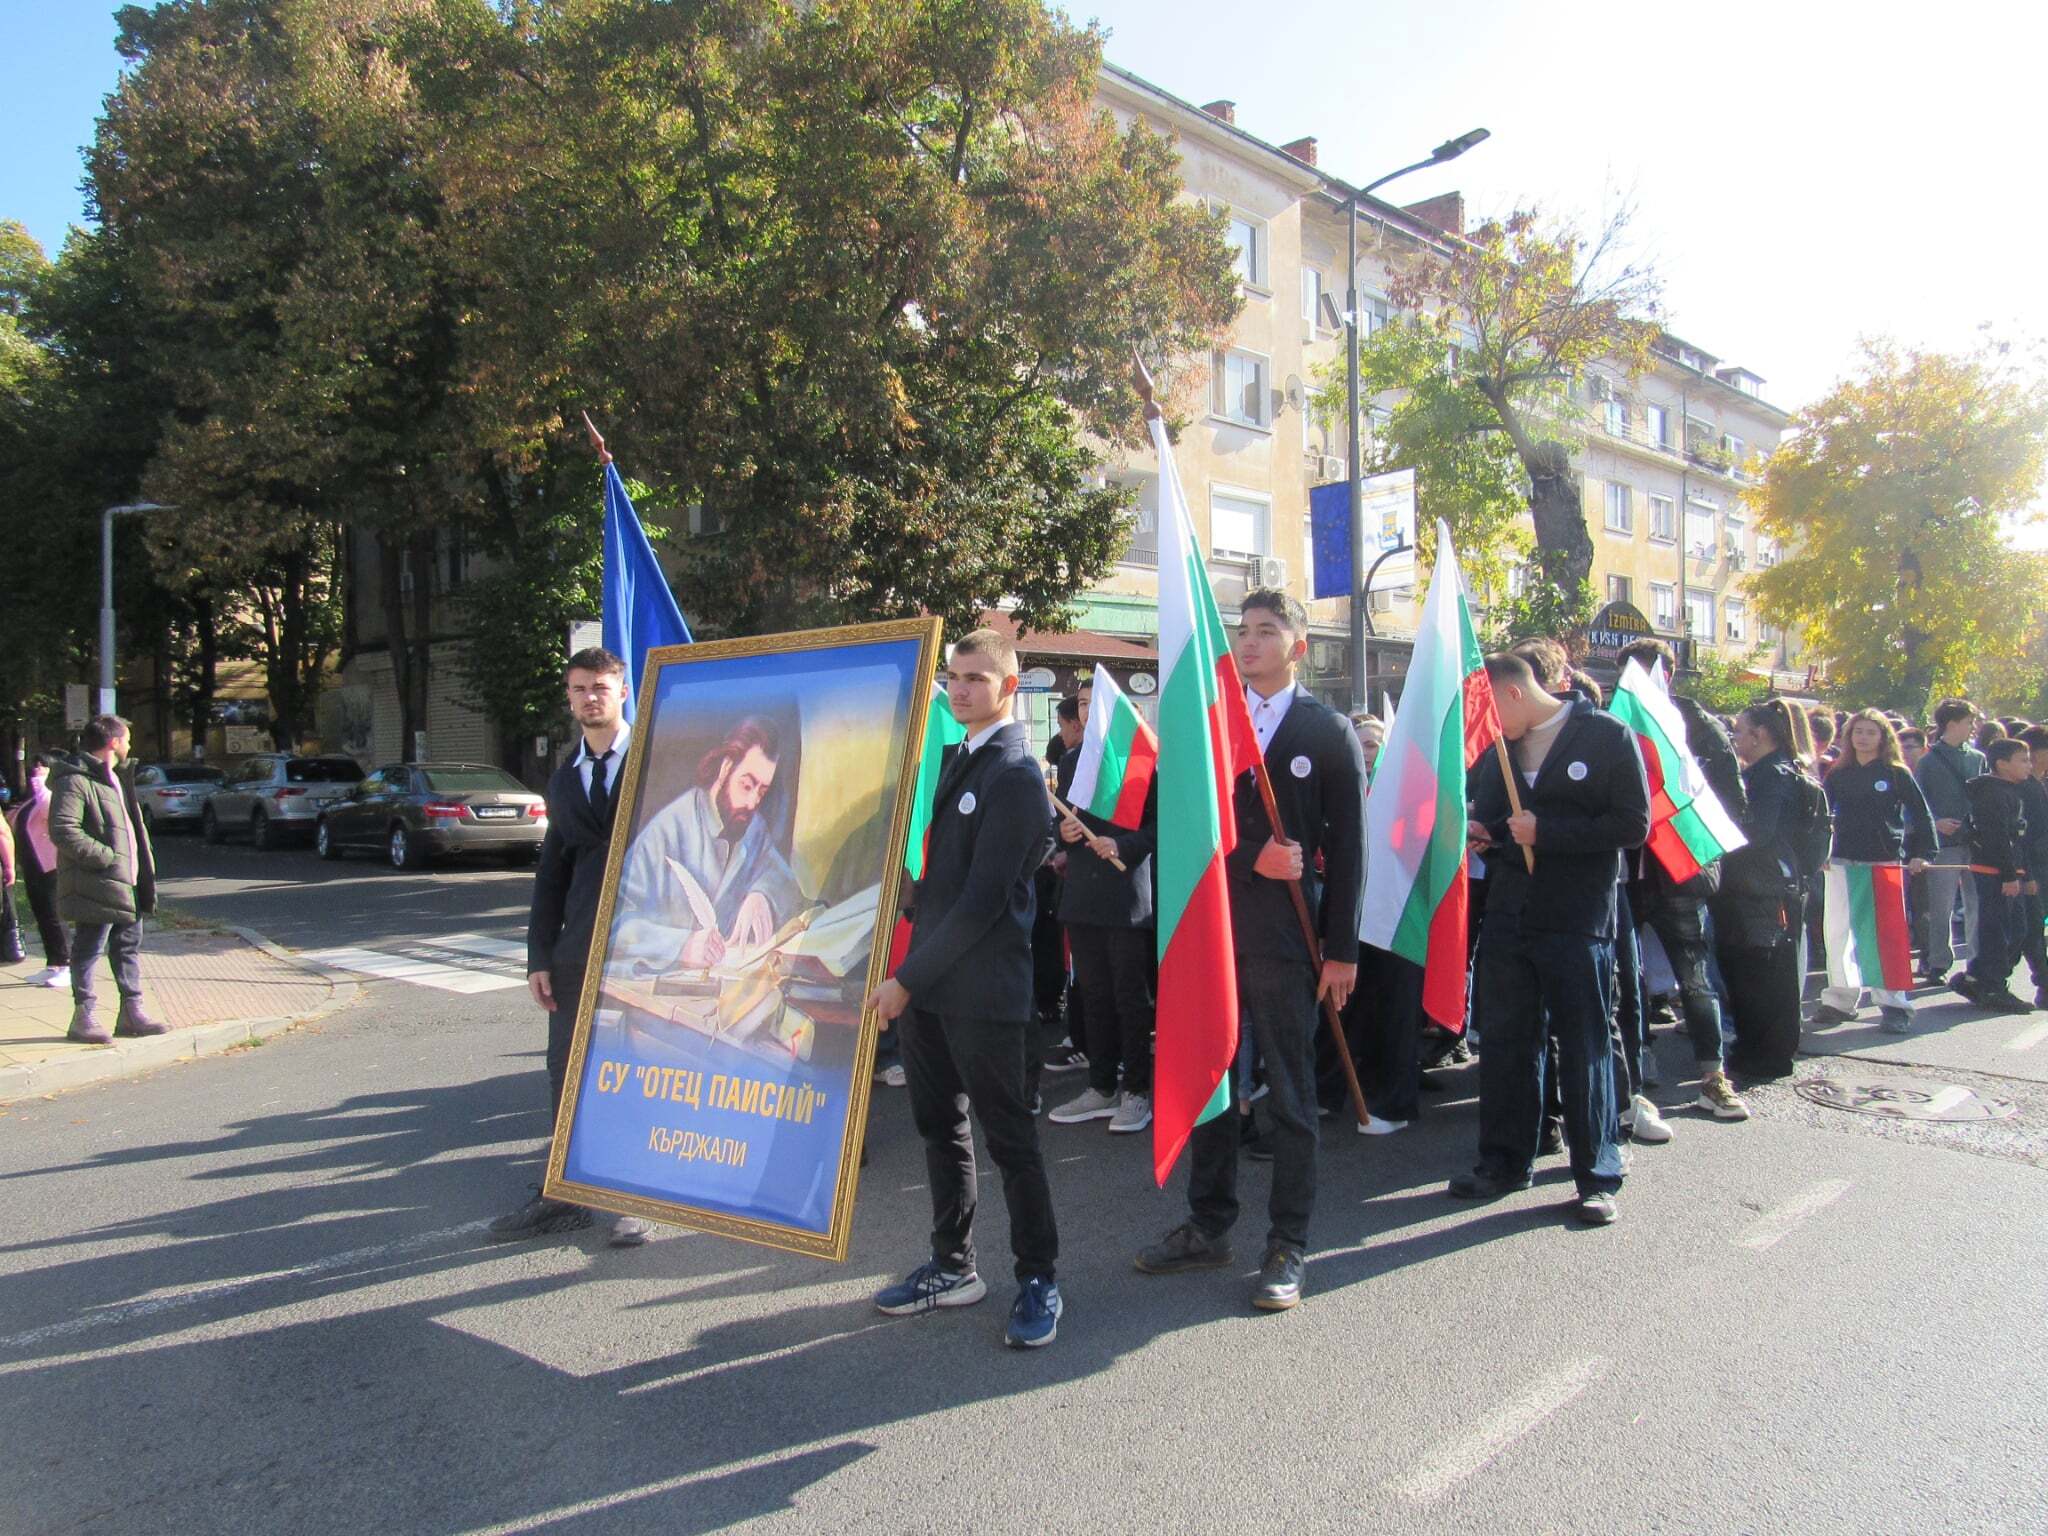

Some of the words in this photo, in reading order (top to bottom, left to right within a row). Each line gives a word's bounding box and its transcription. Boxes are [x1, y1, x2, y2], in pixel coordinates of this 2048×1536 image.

[1591, 631, 1618, 646] KISH
[598, 1061, 630, 1093] СУ
[636, 1066, 702, 1111] "ОТЕЦ
[708, 1075, 826, 1124] ПАИСИЙ"
[648, 1126, 747, 1167] КЪРДЖАЛИ
